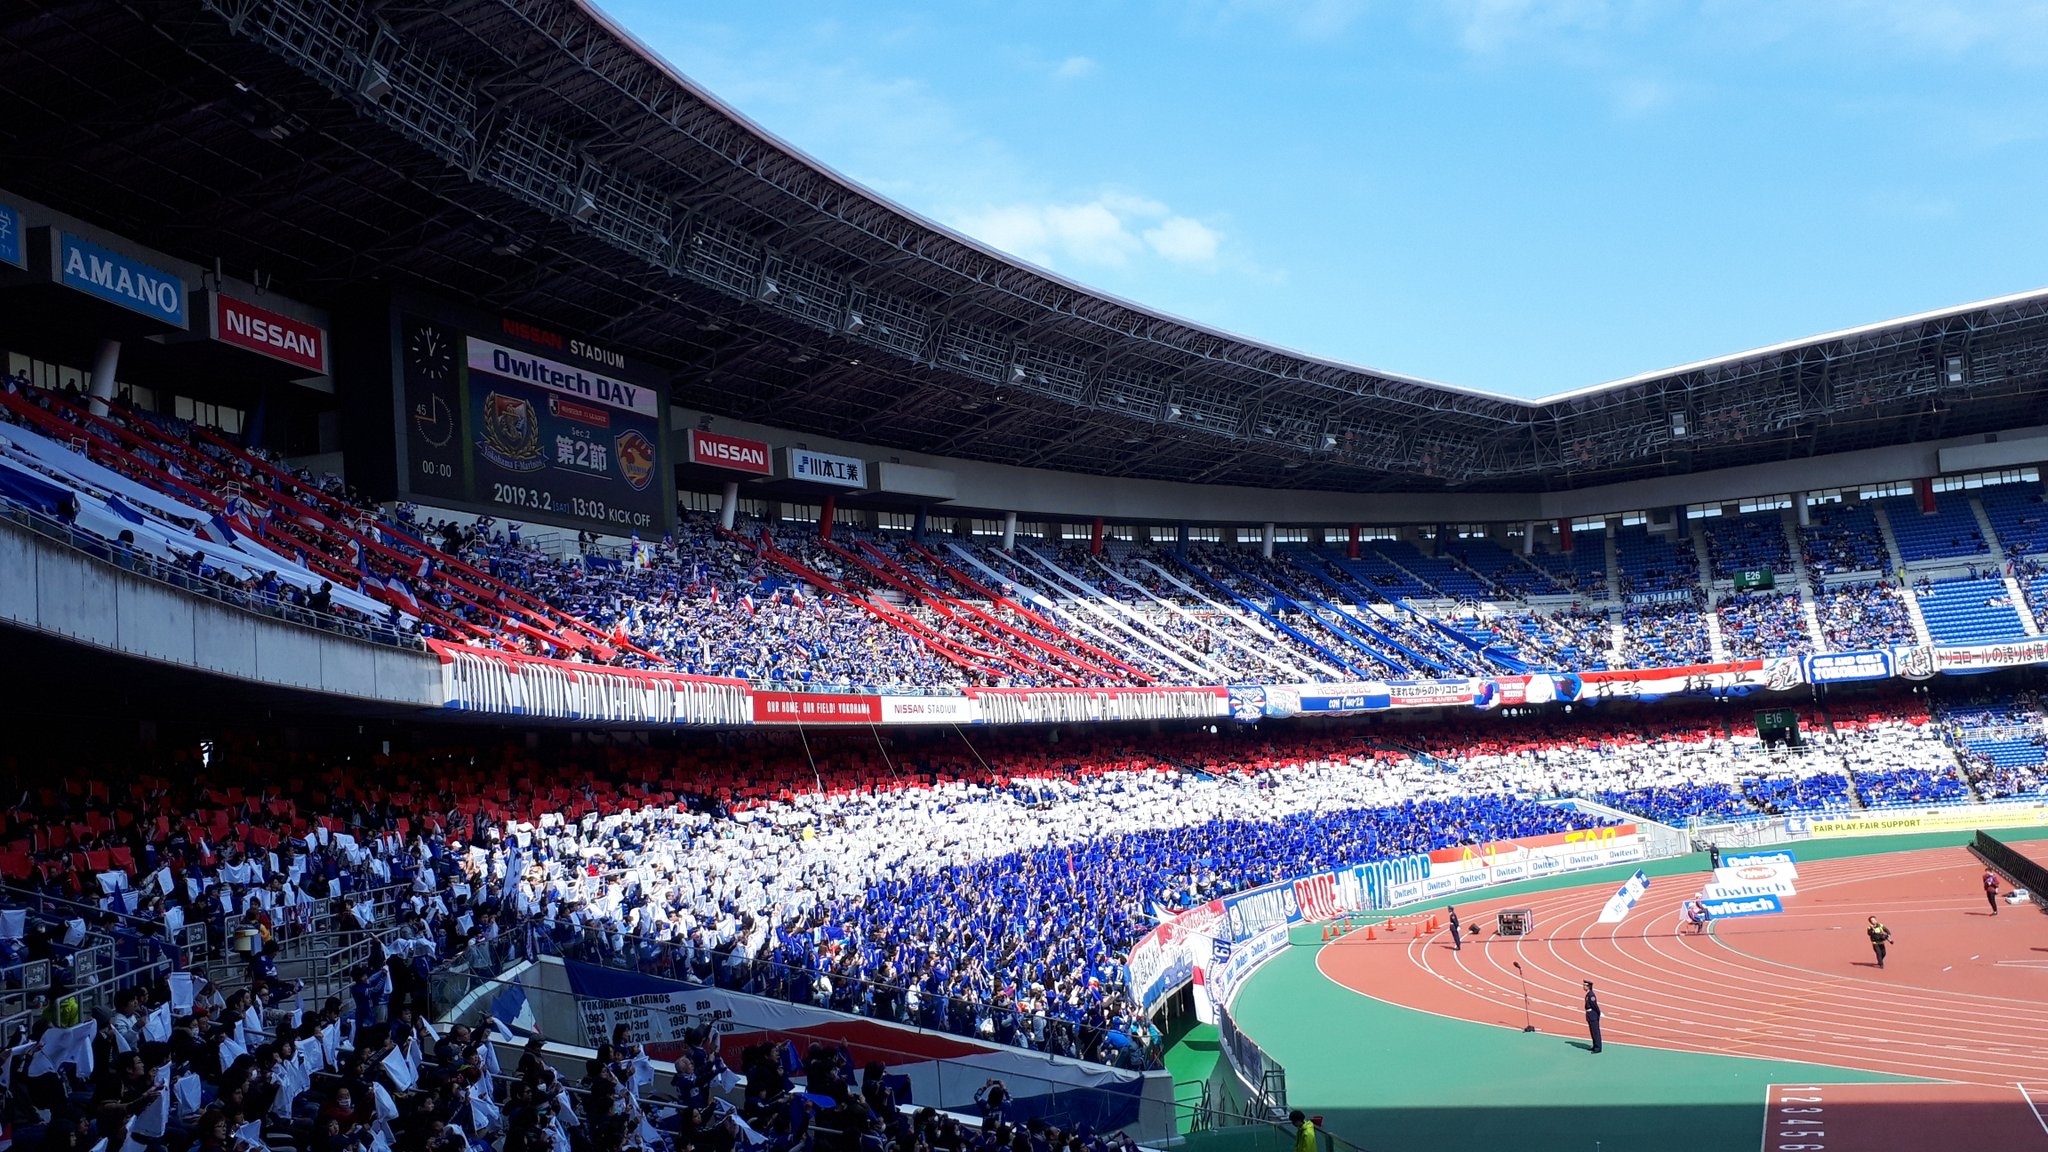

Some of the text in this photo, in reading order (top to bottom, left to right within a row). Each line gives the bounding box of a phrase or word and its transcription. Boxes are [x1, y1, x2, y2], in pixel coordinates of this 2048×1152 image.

[65, 247, 178, 313] AMANO
[226, 309, 316, 358] NISSAN
[502, 318, 625, 369] NISSAN STADIUM
[493, 349, 637, 408] Owltech DAY
[416, 403, 427, 416] 45
[555, 434, 608, 472] 第2節
[700, 440, 764, 465] NISSAN
[422, 460, 452, 478] 00:00
[810, 457, 859, 481] 川本工業
[493, 483, 552, 511] 2019.3.2
[572, 497, 606, 520] 13:03
[608, 507, 632, 524] KICK
[633, 512, 651, 527] OFF
[1745, 571, 1761, 581] E26
[1812, 662, 1887, 680] YOKOHAMA
[767, 700, 871, 715] OUR HOME, OUR FIELD! YOKOHAMA
[894, 704, 957, 714] NISSAN STADIUM
[1765, 713, 1783, 725] E16
[1813, 824, 1833, 833] FAIR
[1860, 821, 1879, 830] FAIR
[1881, 818, 1921, 828] SUPPORT
[1569, 852, 1599, 865] Owltech
[1294, 874, 1337, 921] PRIDE
[1715, 882, 1787, 897] Owltech
[1700, 898, 1775, 916] wltech
[581, 994, 671, 1011] YOKOHAMA MARINOS
[585, 1000, 711, 1023] 1993 3rd/3rd 1996 8th
[587, 1024, 607, 1035] 1994
[669, 1015, 689, 1027] 1997
